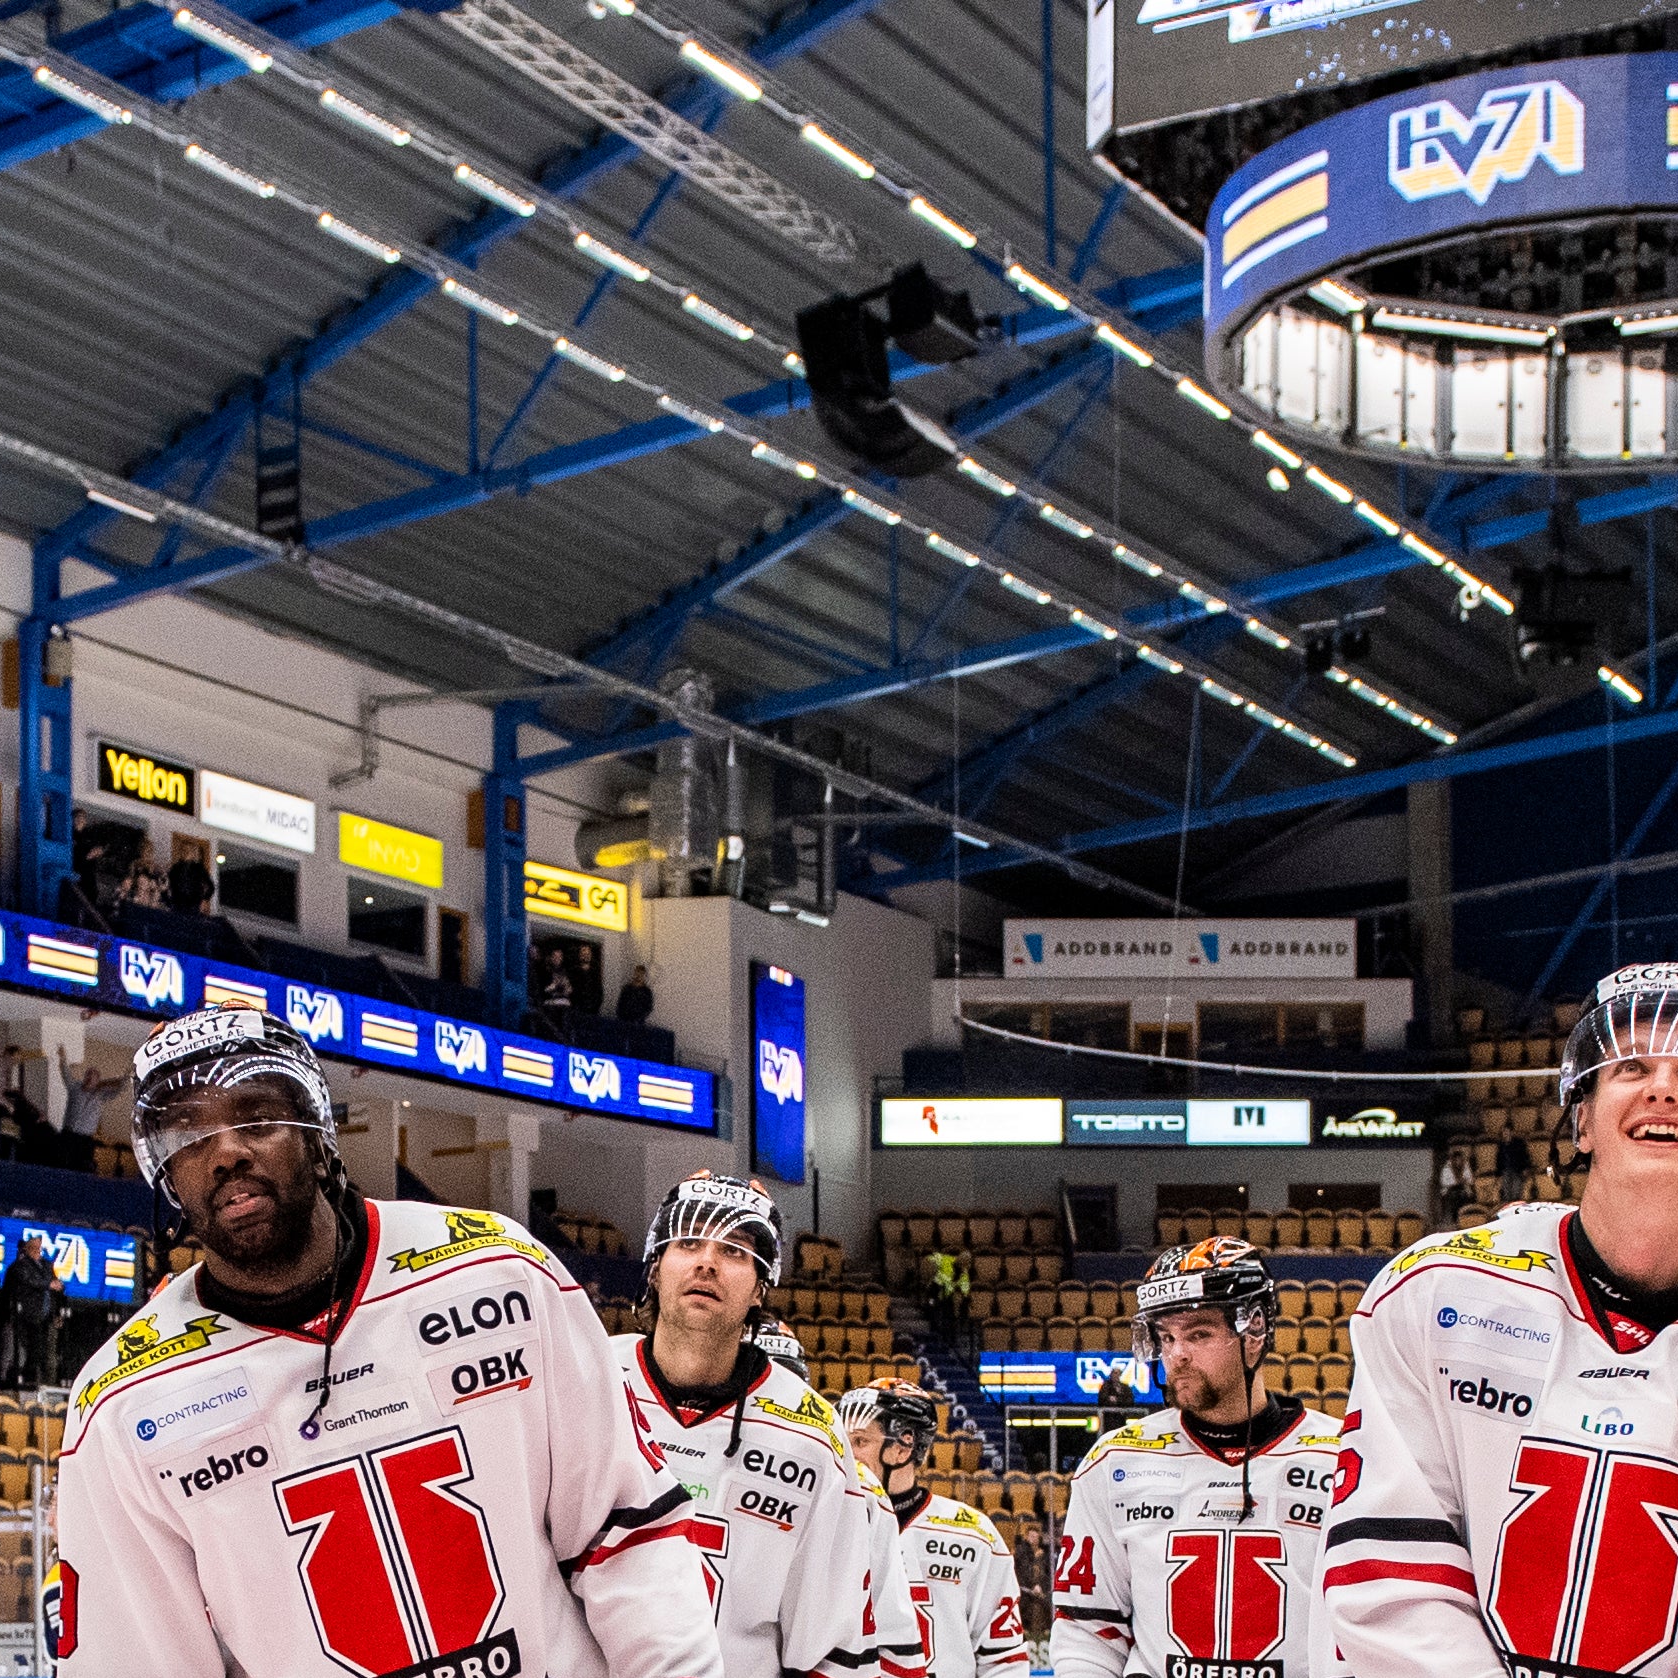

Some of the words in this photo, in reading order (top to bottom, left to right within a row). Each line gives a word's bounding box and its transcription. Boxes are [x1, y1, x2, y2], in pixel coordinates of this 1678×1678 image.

[106, 748, 187, 807] Yellon
[1053, 941, 1174, 957] ADDBRAND
[1229, 941, 1349, 958] ADDBRAND
[1071, 1114, 1187, 1132] TOSITO
[1459, 1312, 1552, 1345] CONTRACTING
[304, 1361, 375, 1394] BAUER
[450, 1347, 531, 1396] OBK
[1577, 1364, 1652, 1382] BAUER
[156, 1384, 249, 1430] CONTRACTING
[1449, 1376, 1534, 1418] rebro
[323, 1406, 357, 1433] Grant
[356, 1399, 410, 1424] Thornton
[179, 1442, 270, 1498] rebro
[740, 1490, 800, 1526] OBK
[1126, 1503, 1175, 1523] rebro
[927, 1563, 965, 1581] OBK
